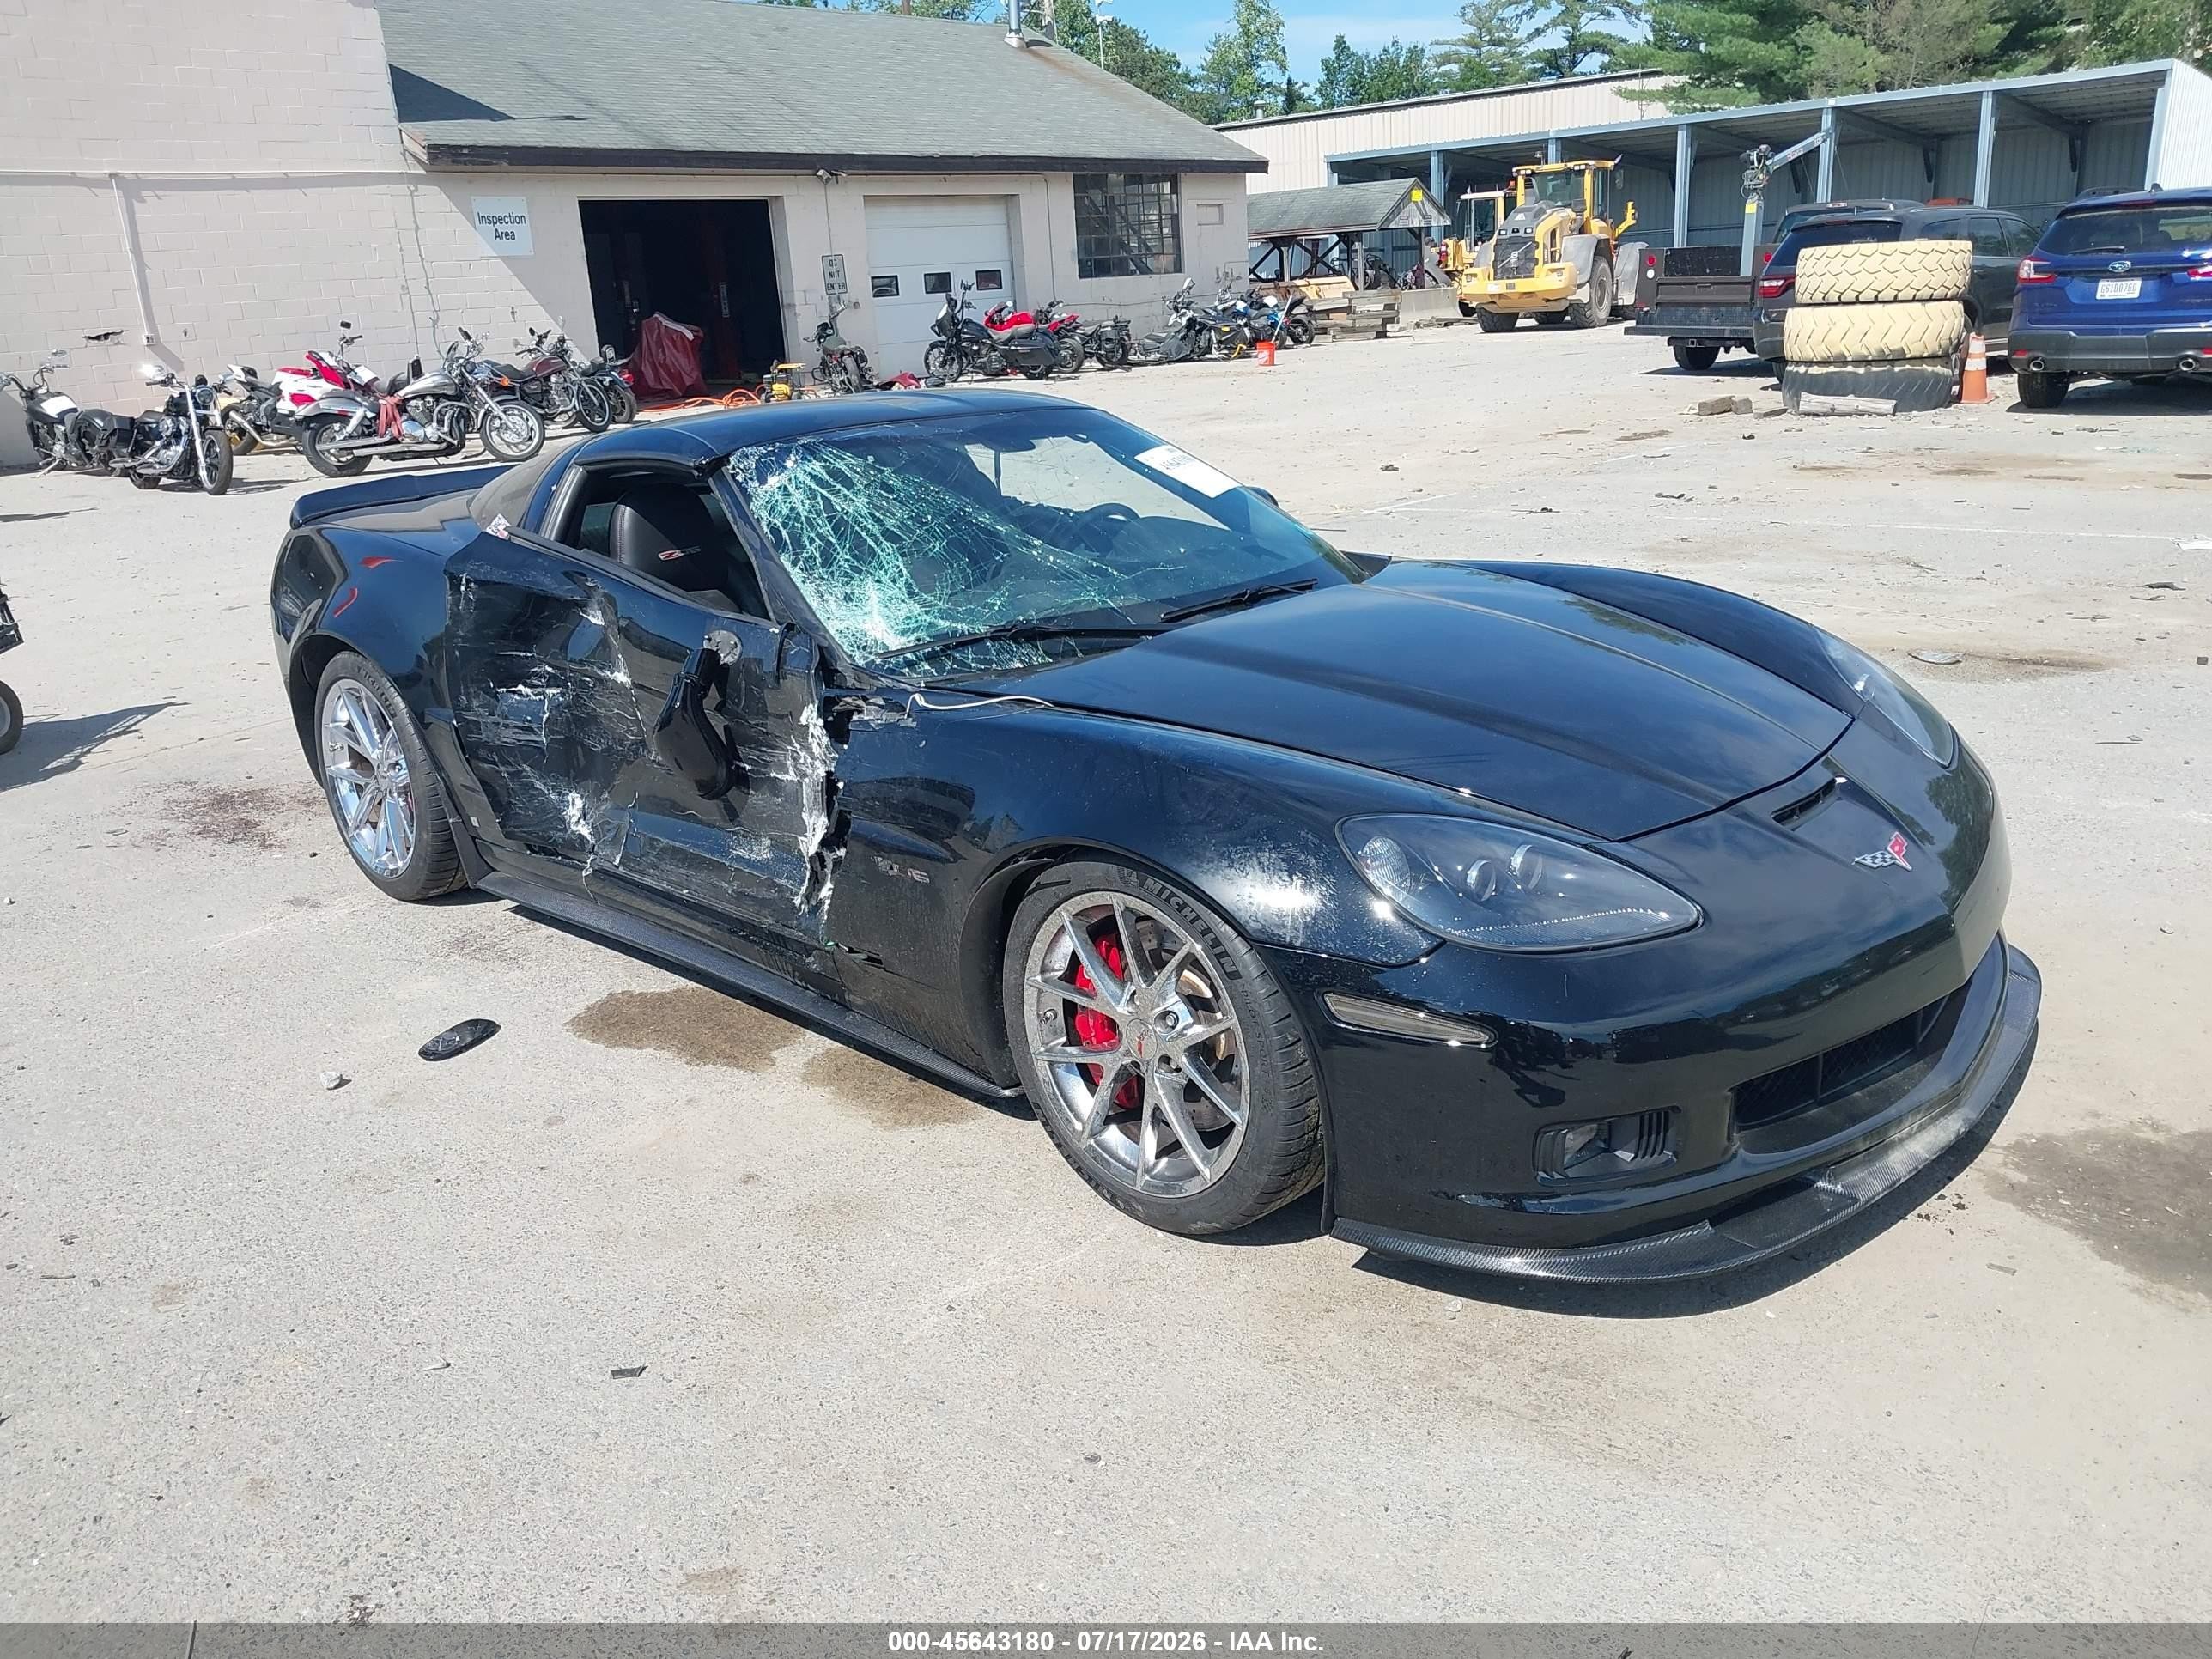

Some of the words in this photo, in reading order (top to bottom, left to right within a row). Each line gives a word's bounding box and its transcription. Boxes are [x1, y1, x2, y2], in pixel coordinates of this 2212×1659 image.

[477, 211, 526, 227] Inspection
[495, 228, 516, 240] Area
[827, 283, 845, 291] ENER
[1143, 878, 1237, 972] MICHELIN
